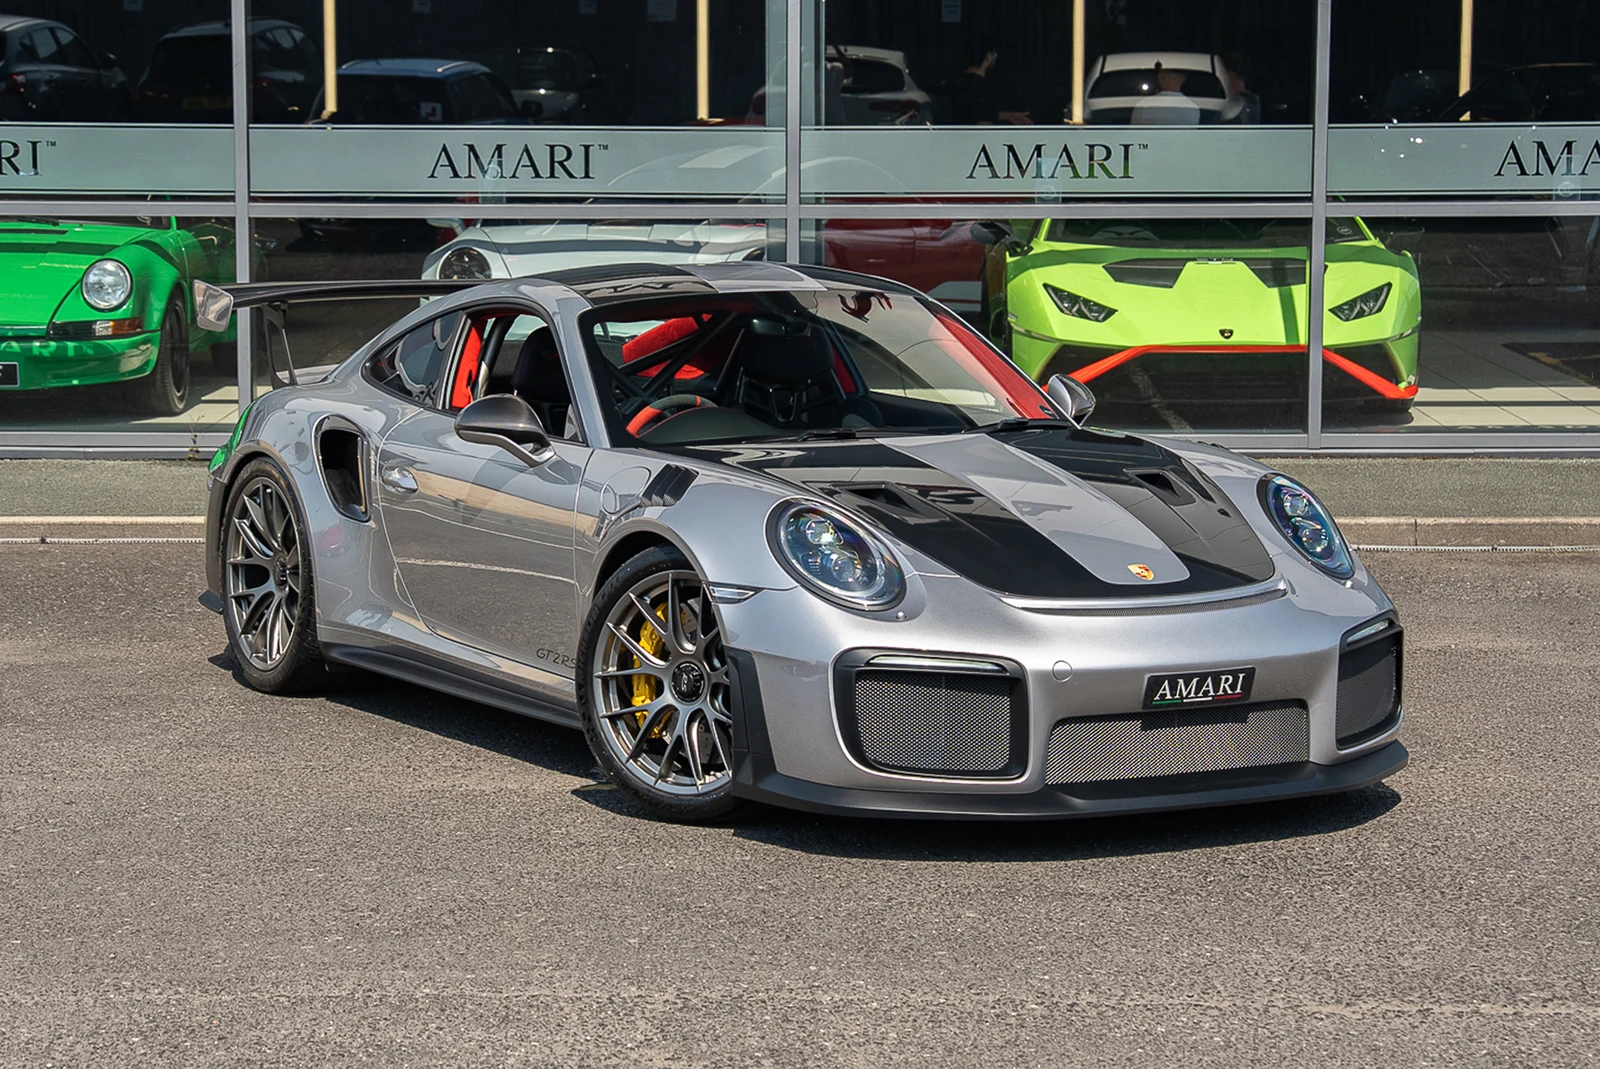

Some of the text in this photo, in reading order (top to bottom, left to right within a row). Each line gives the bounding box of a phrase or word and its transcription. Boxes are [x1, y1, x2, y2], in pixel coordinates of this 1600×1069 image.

[427, 143, 595, 179] AMARI
[966, 143, 1134, 179] AMARI
[1154, 673, 1245, 700] AMARI
